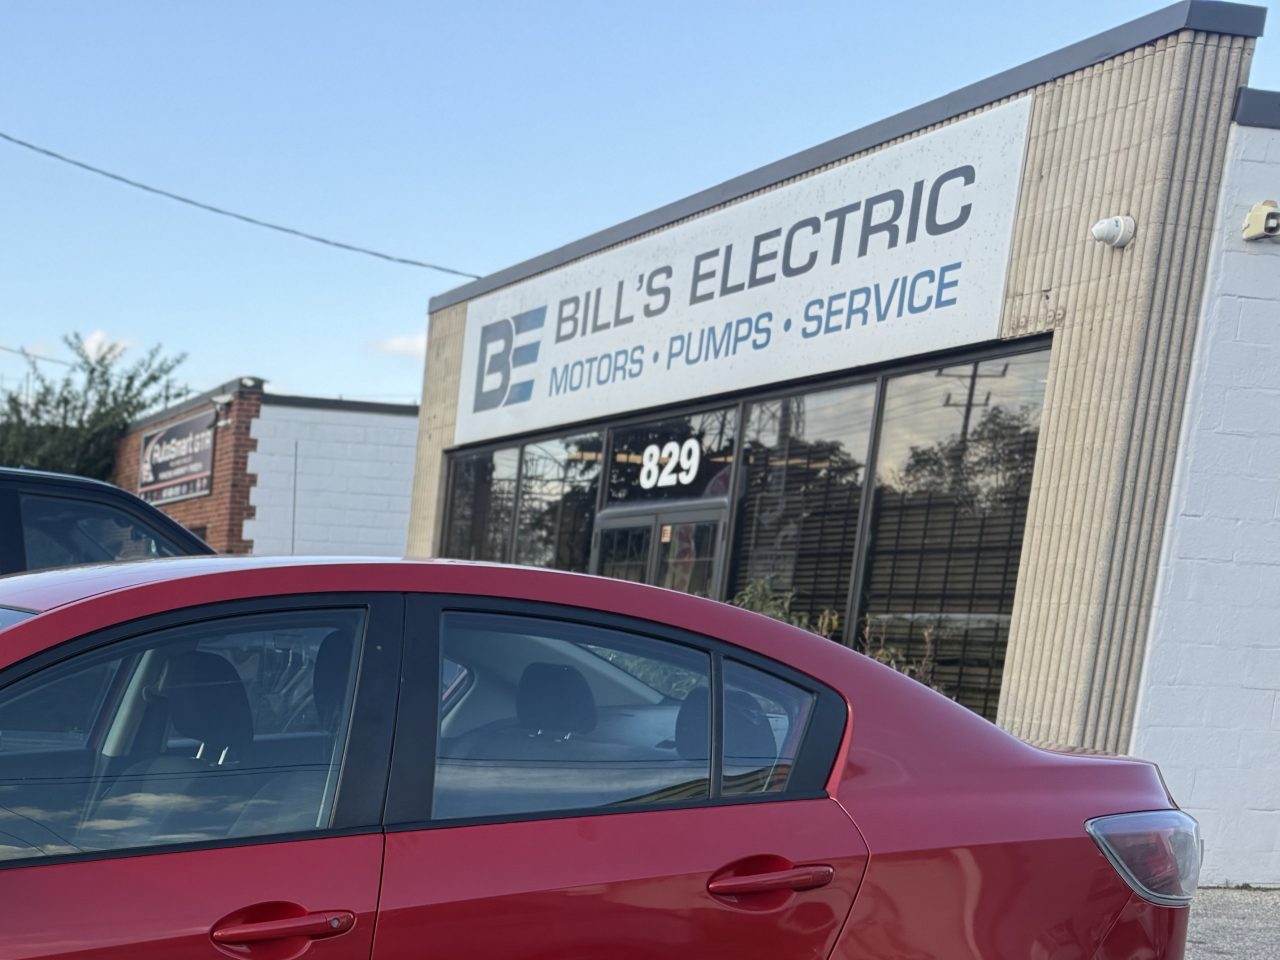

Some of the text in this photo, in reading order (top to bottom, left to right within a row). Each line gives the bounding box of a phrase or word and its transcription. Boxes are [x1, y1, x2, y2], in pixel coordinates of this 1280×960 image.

[555, 164, 976, 344] BILL'S ELECTRIC
[473, 304, 548, 414] BE
[548, 261, 962, 397] MOTORS PUMPS SERVICE
[639, 437, 701, 490] 829
